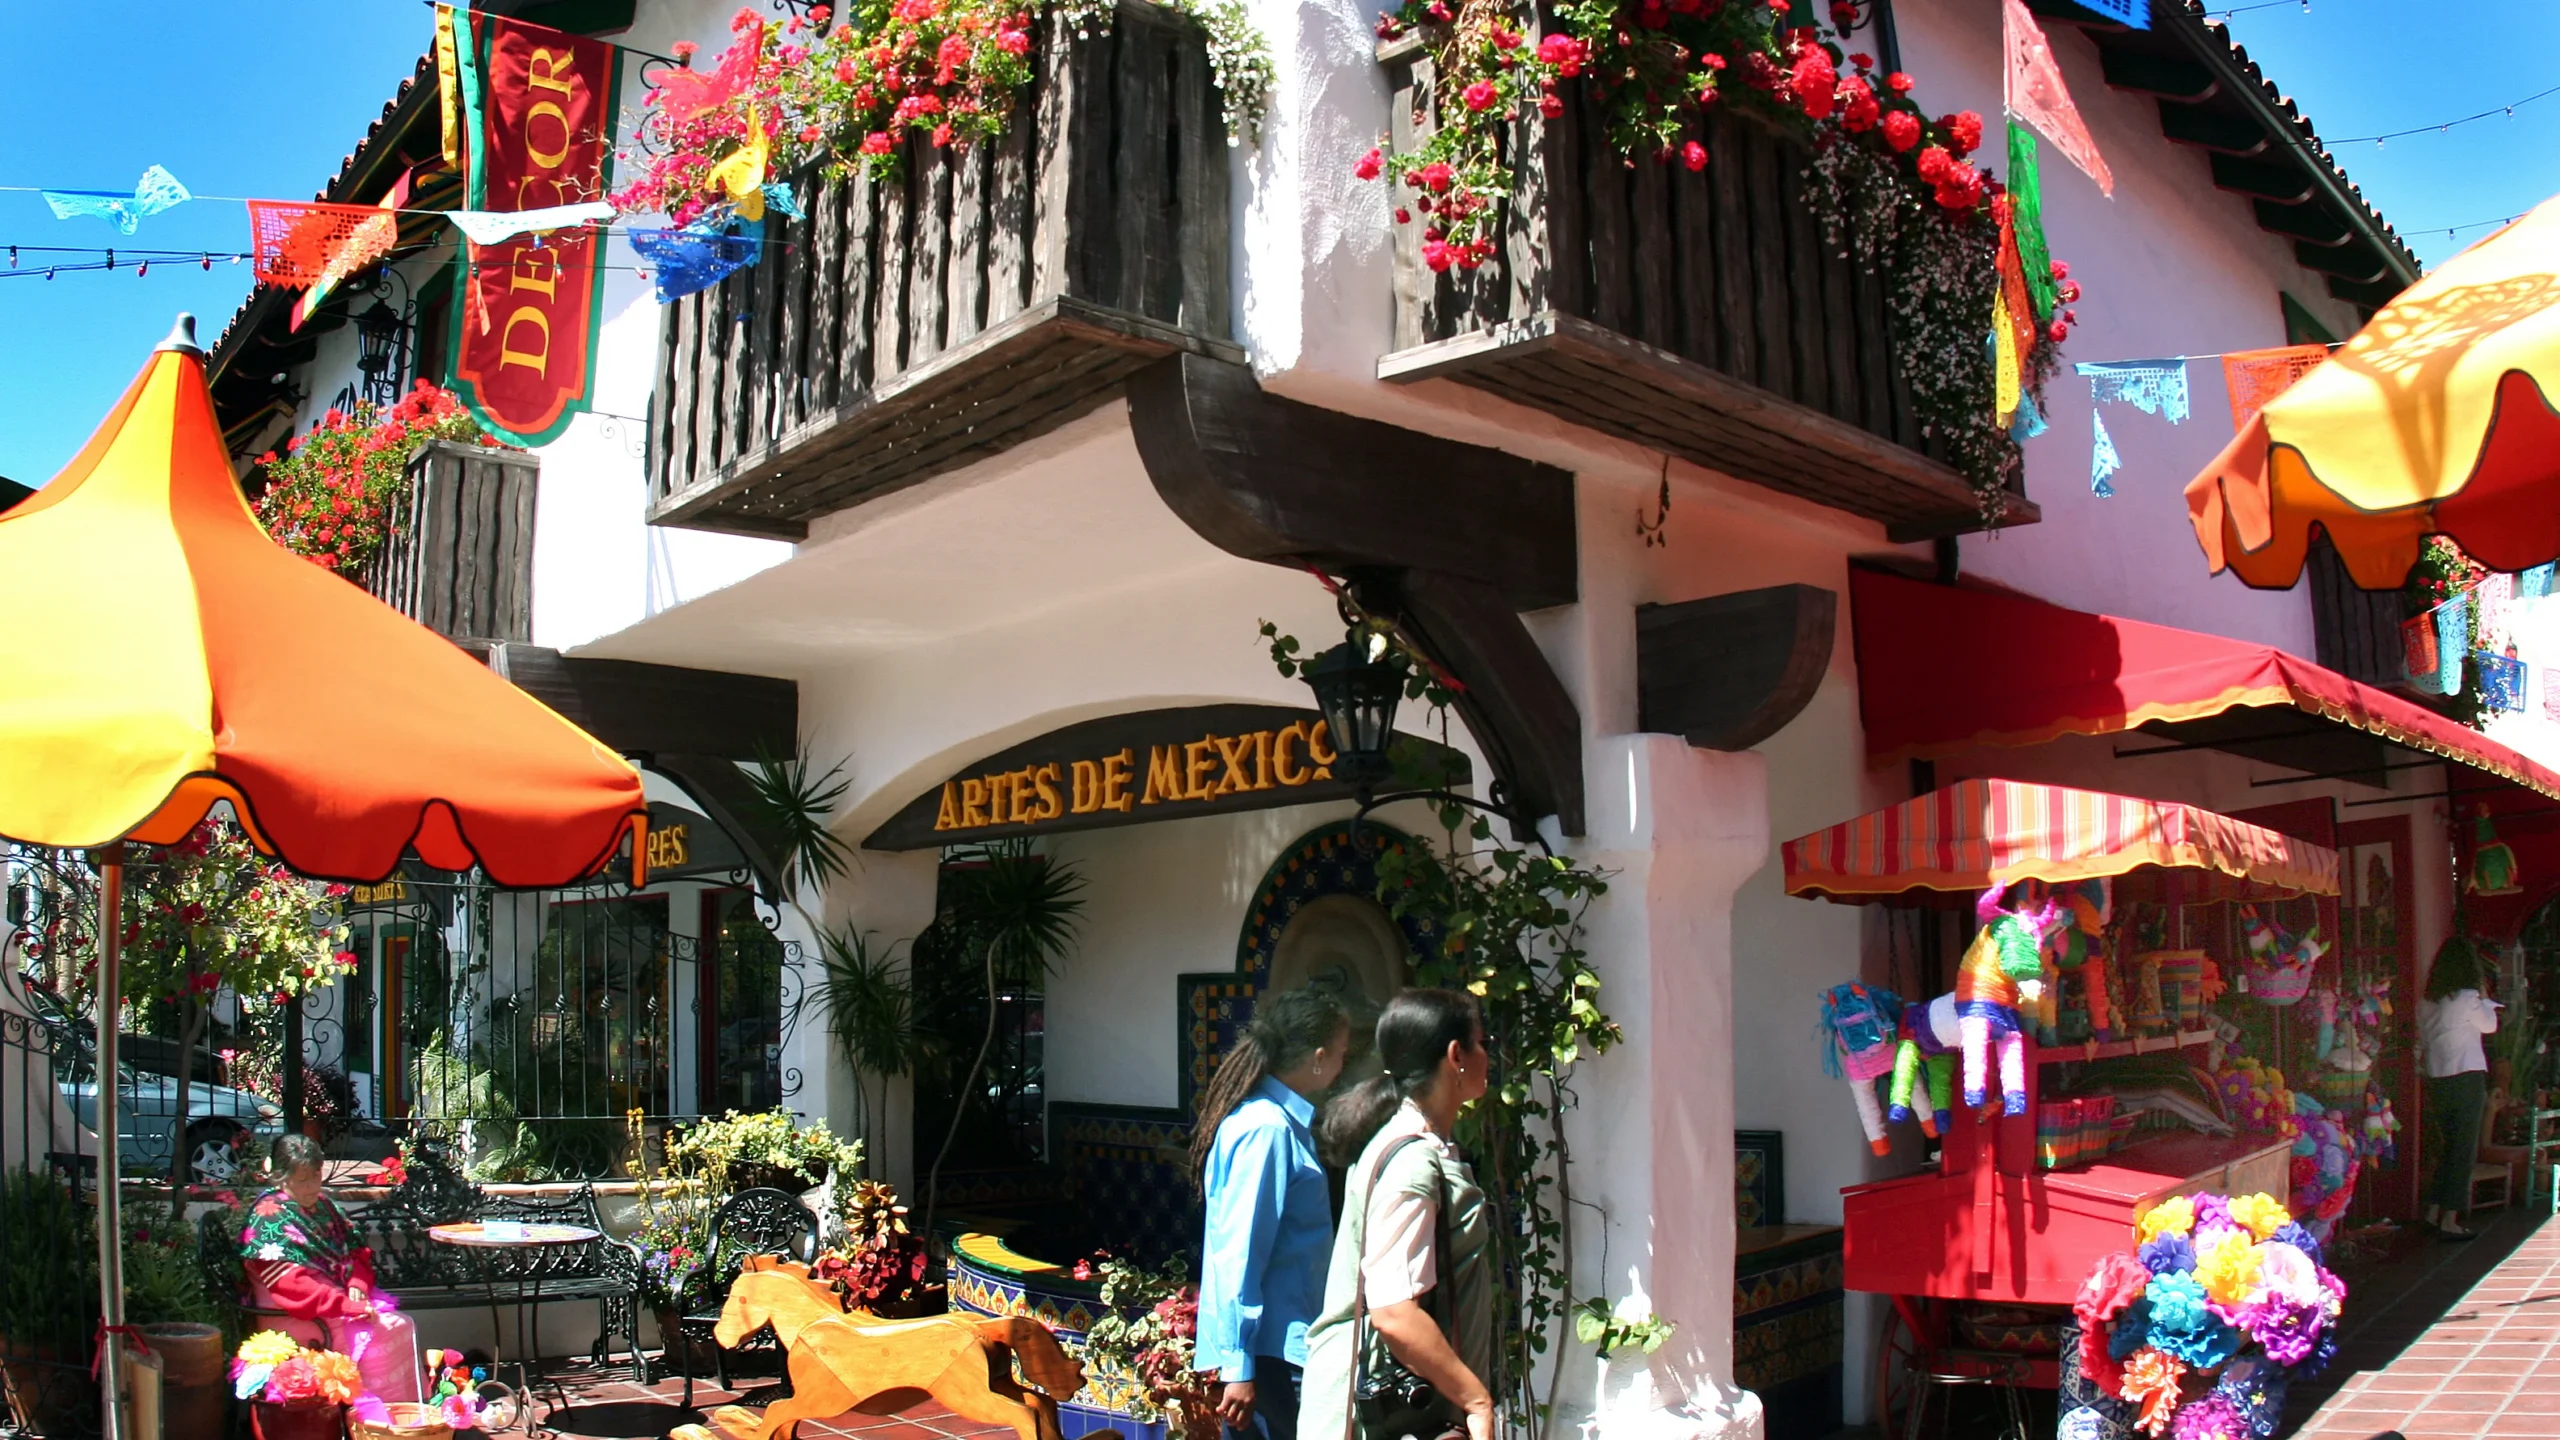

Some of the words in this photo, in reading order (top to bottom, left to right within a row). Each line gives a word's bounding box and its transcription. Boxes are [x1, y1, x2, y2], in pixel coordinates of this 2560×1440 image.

[500, 46, 575, 380] DECOR
[934, 763, 1063, 830] ARTES
[1071, 748, 1134, 812] DE
